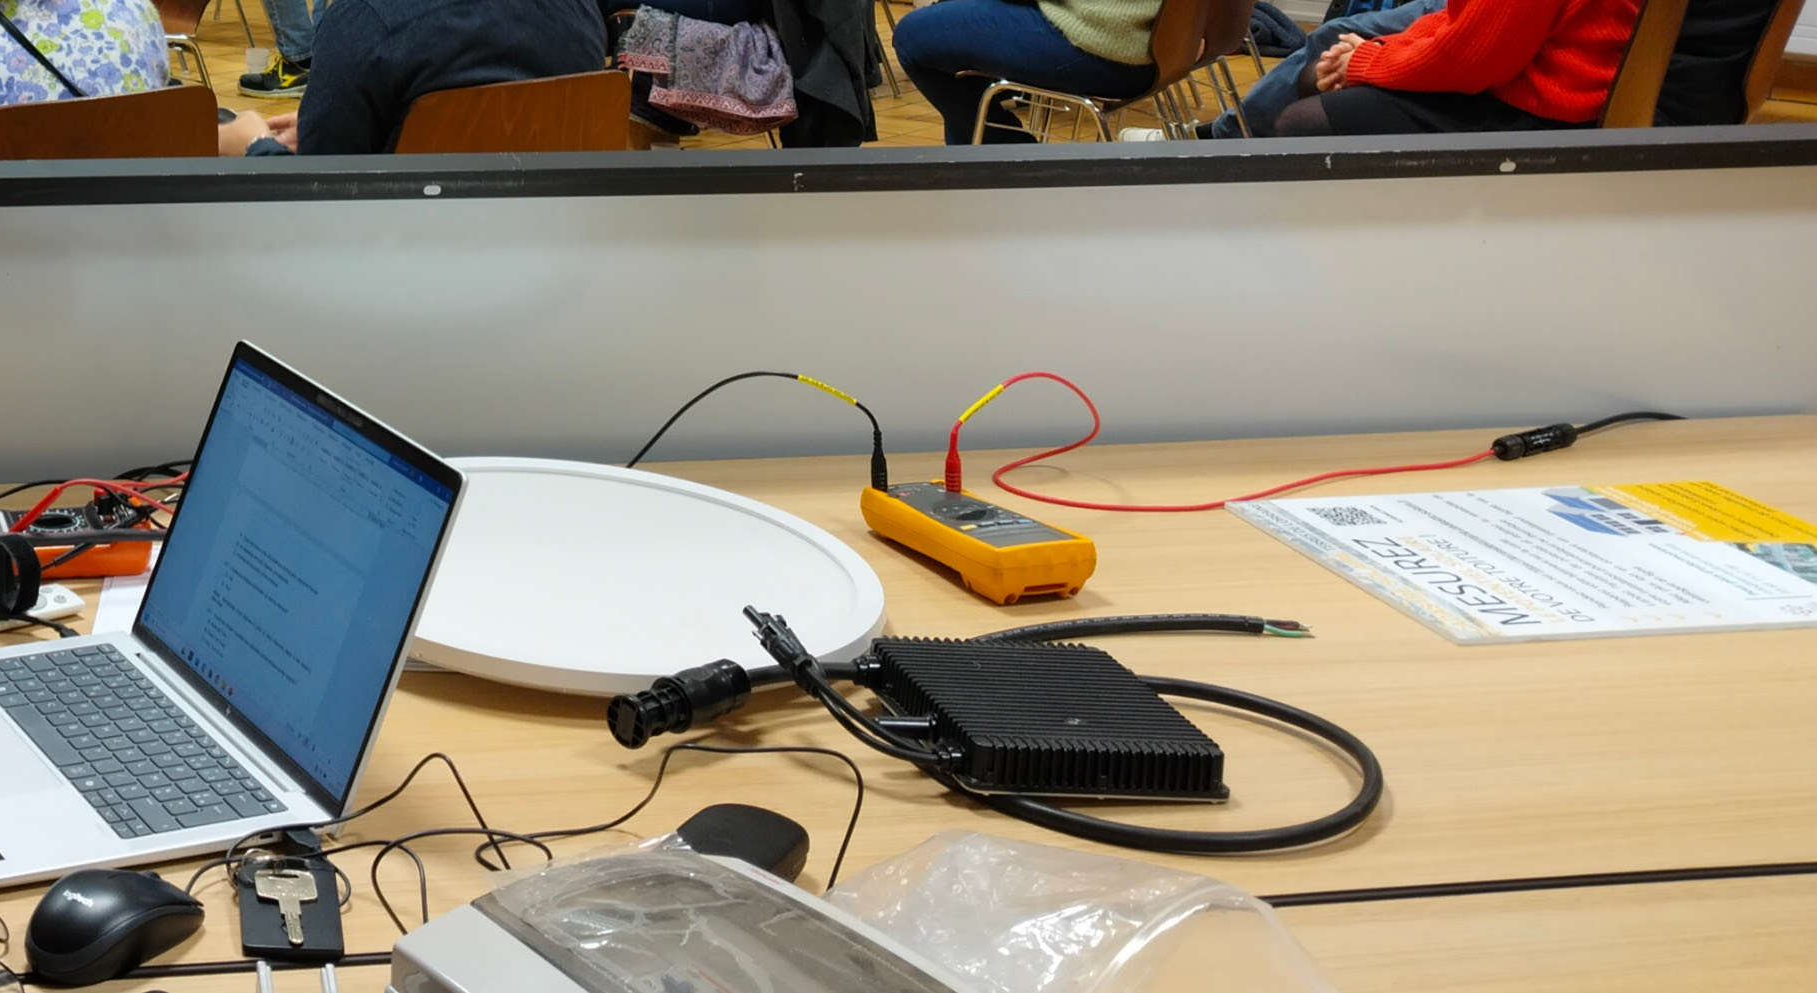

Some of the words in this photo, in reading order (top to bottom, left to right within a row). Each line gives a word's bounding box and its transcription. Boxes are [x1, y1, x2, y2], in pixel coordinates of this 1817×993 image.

[1426, 538, 1505, 575] TOITURE
[1351, 537, 1541, 625] MESUREZ
[1497, 576, 1565, 608] VOTRE
[1557, 608, 1595, 622] DE
